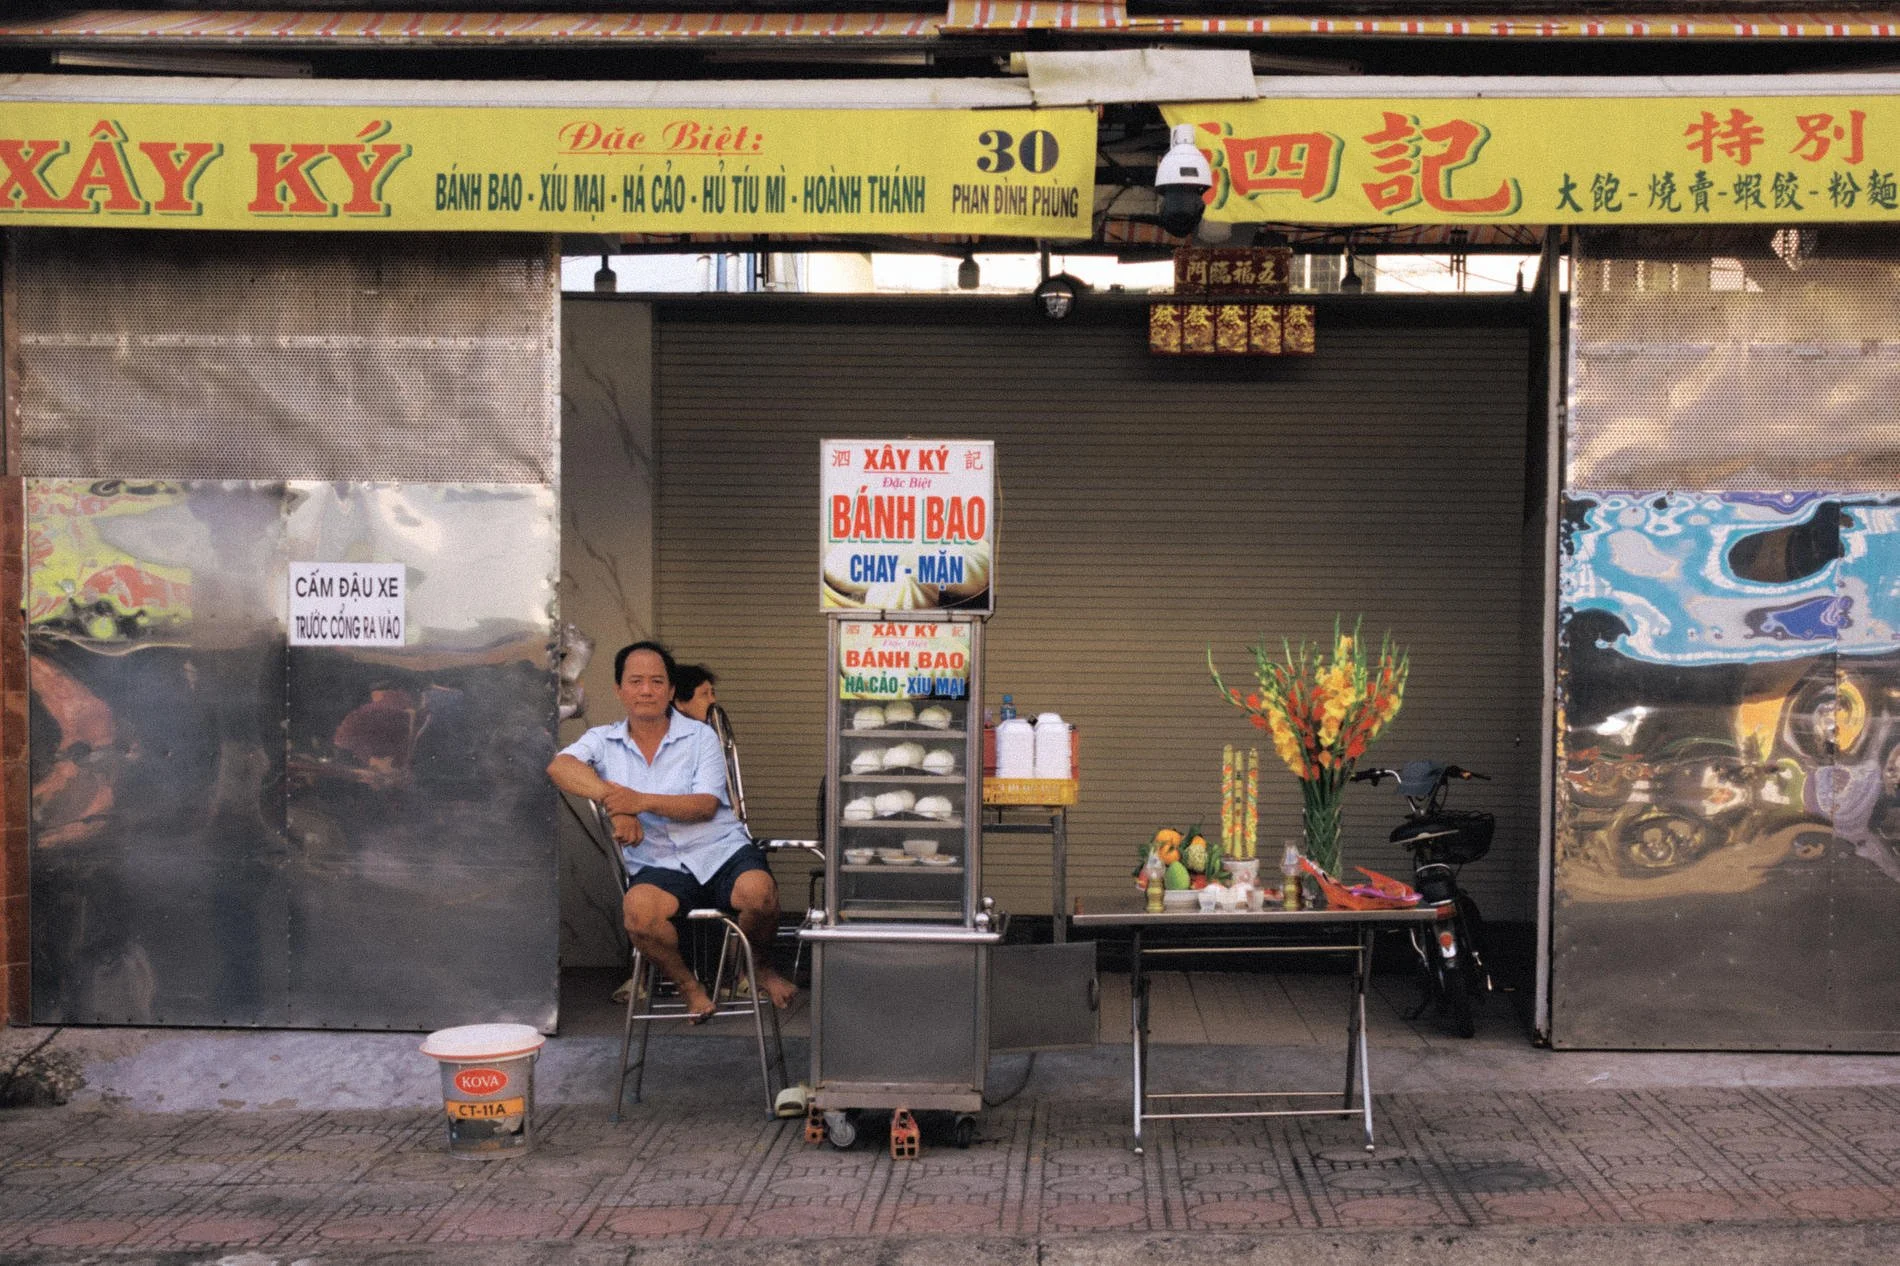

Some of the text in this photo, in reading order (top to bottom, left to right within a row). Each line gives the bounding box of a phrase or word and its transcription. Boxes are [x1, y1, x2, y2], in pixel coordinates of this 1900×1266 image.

[976, 130, 1059, 173] 30
[1683, 108, 1867, 166] 特別
[0, 119, 413, 217] XÂY KÝ
[435, 163, 483, 212] BÁNH
[488, 173, 523, 212] BAO
[539, 163, 568, 213] XÍU
[574, 174, 606, 221] MẠI
[622, 164, 646, 214] HÁ
[651, 160, 686, 214] CẢO
[702, 160, 726, 214] HỦ
[731, 165, 759, 214] TÍU
[765, 165, 786, 213] MÌ
[803, 165, 862, 214] HOÀNH
[867, 165, 926, 214] THÁNH
[952, 177, 1079, 218] PHAN ĐÌNH PHÙNG
[864, 444, 950, 471] XÂY KÝ
[964, 450, 984, 471] 記
[829, 486, 986, 545] BÁNH BAO
[295, 569, 399, 602] CẤM ĐẬU XE
[850, 555, 899, 583] CHAY
[918, 550, 964, 590] MẶN
[330, 603, 361, 639] CỔNG
[363, 616, 377, 639] RA
[378, 610, 401, 639] VÀO
[845, 648, 964, 669] BÁNH BAO
[845, 672, 866, 693] HÁ
[868, 671, 898, 694] CẢO
[907, 673, 932, 695] XÍU
[935, 677, 966, 699] MẠI
[462, 1075, 500, 1089] KOVA
[458, 1103, 507, 1116] CT-11A
